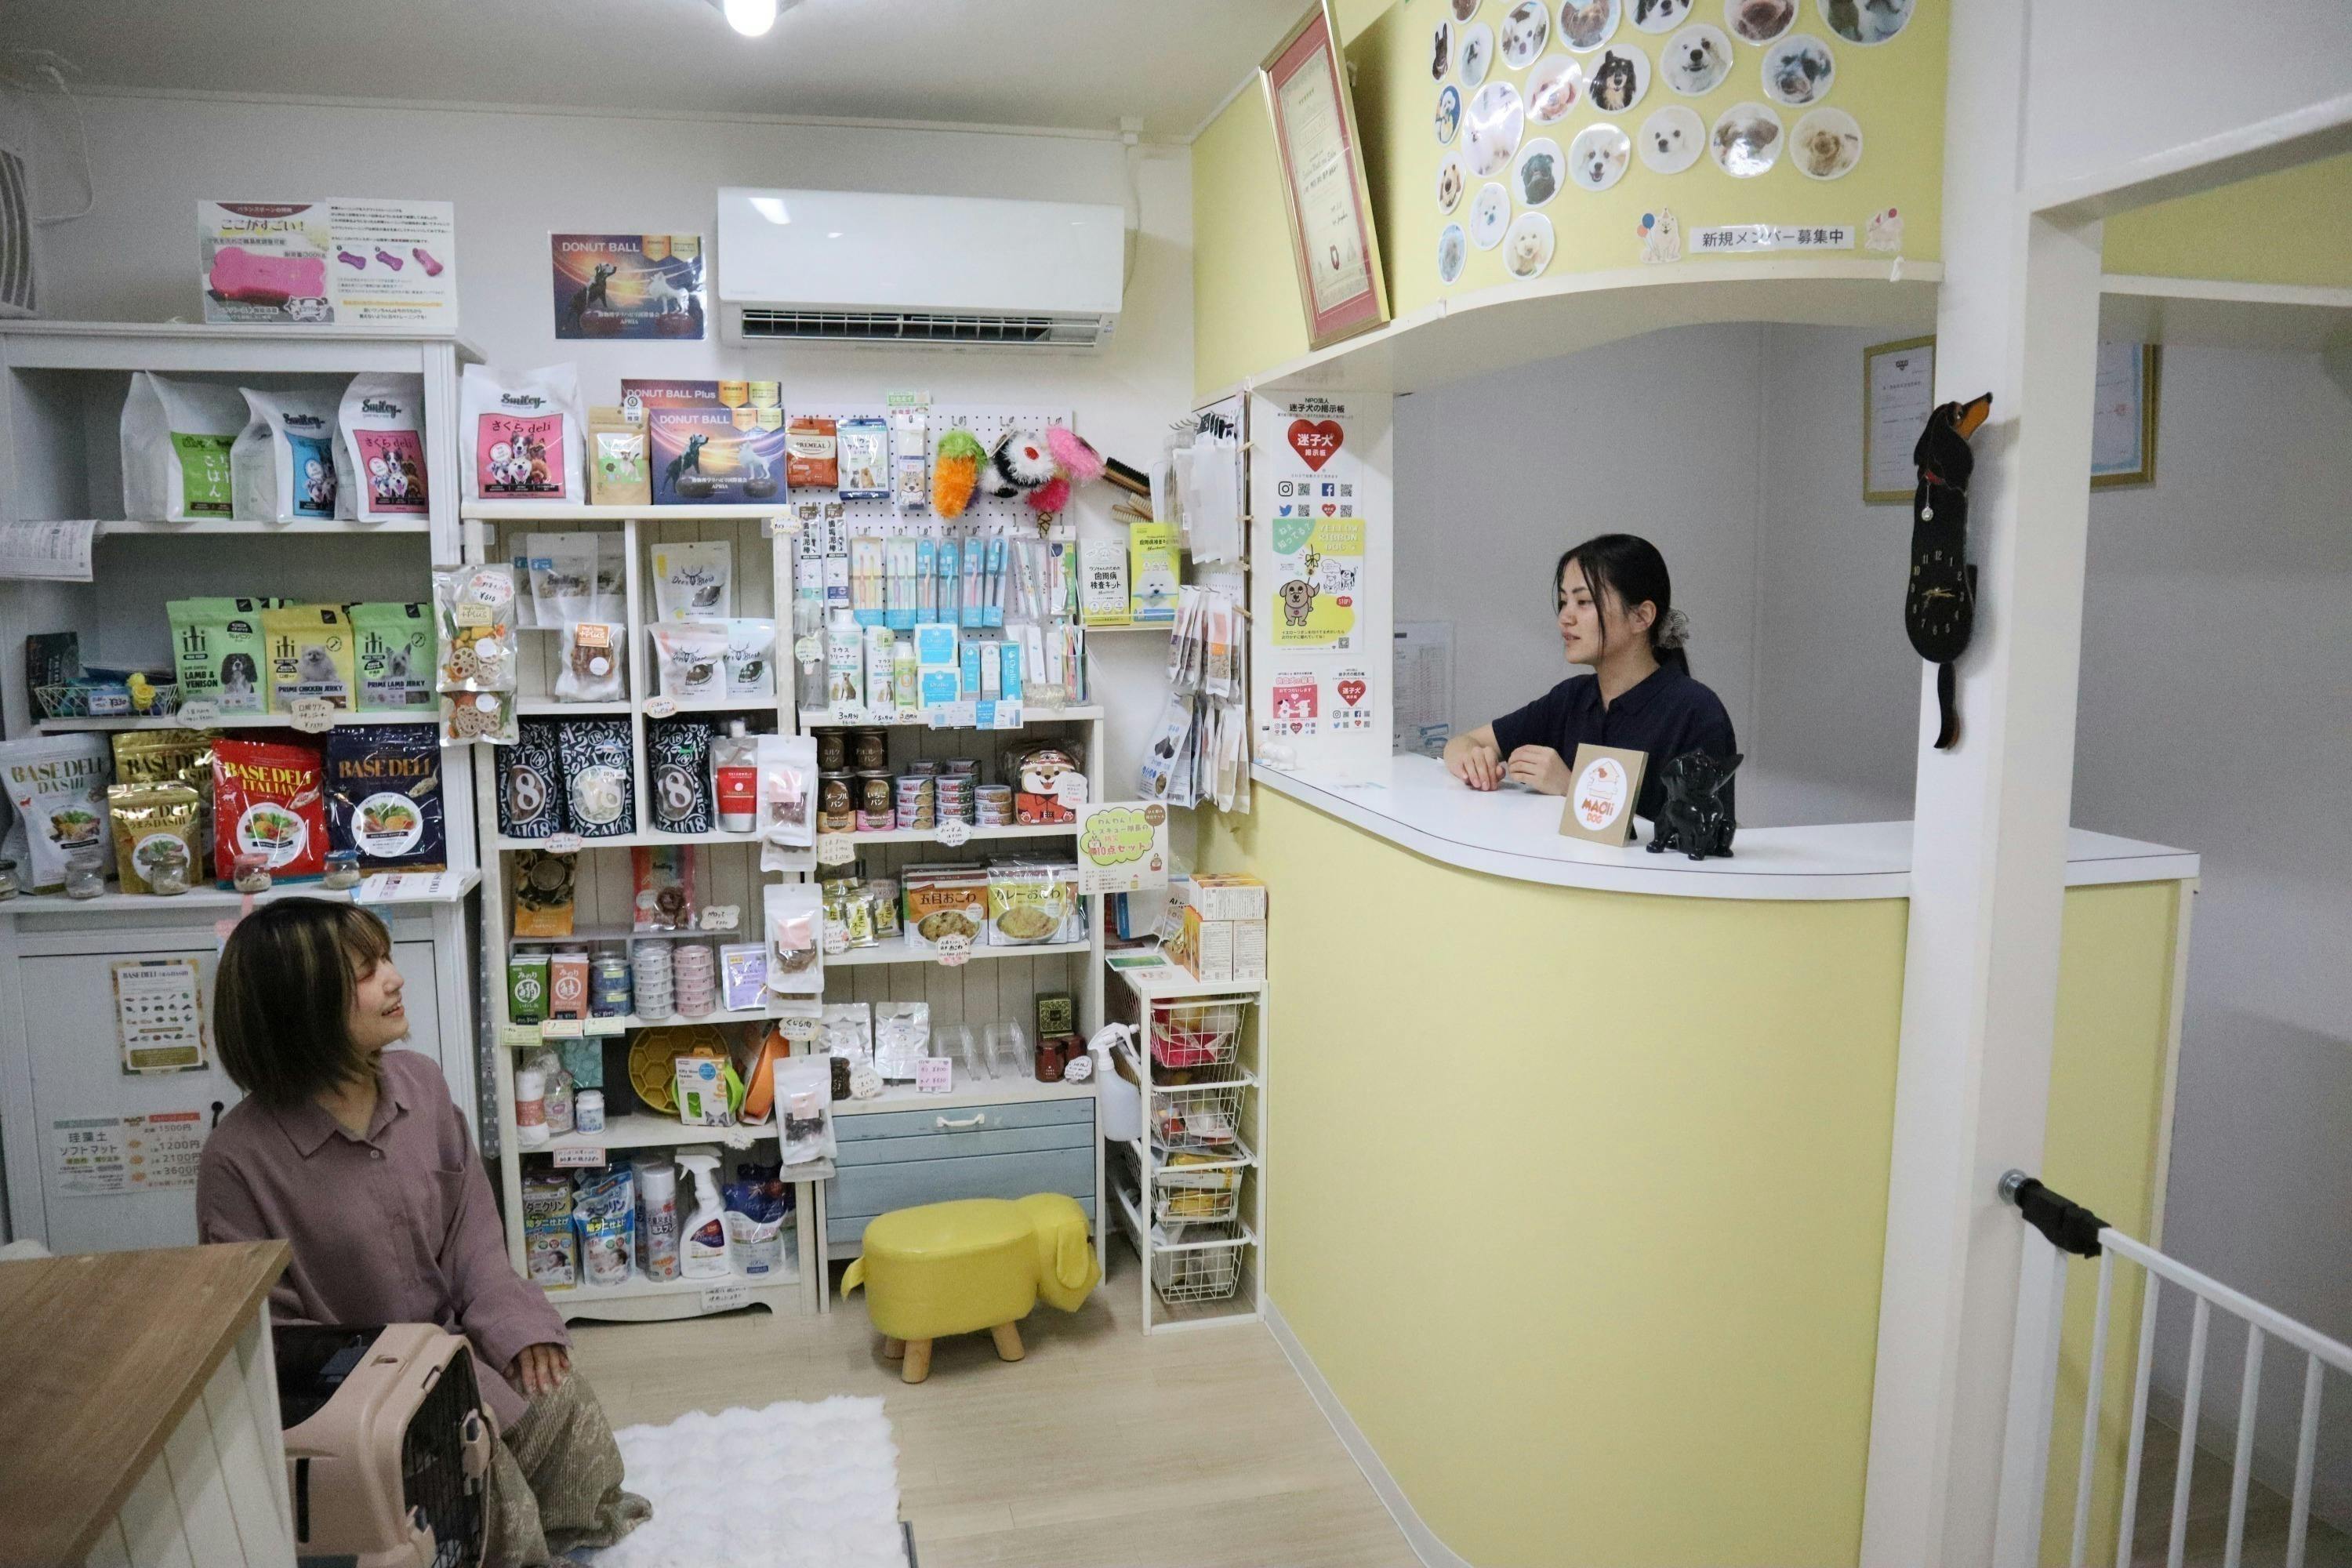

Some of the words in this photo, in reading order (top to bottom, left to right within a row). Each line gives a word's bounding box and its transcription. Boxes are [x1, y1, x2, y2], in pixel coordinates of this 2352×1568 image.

[1702, 228, 1844, 247] 新規メンバー募集中
[561, 242, 605, 252] DONUT
[608, 242, 640, 252] BALL
[626, 389, 664, 398] DONUT
[666, 389, 692, 398] BALL
[500, 393, 546, 408] Smiley
[362, 399, 401, 419] Smiley
[1289, 404, 1345, 413] 迷子犬の掲示板
[659, 415, 699, 424] DONUT
[702, 416, 730, 424] BALL
[492, 420, 524, 433] さくら
[528, 423, 551, 433] deli
[365, 437, 391, 448] さくら
[394, 437, 413, 448] deli
[1298, 434, 1333, 446] 迷子犬
[1922, 554, 1929, 564] 11
[1935, 550, 1942, 561] 12
[1914, 565, 1920, 575] 10
[1957, 571, 1962, 580] 2
[1911, 583, 1915, 593] 9
[1960, 591, 1964, 602] 3
[1933, 625, 1937, 635] 6
[1945, 623, 1950, 633] 5
[184, 671, 207, 680] LAMB
[186, 680, 218, 688] VENISON
[11, 761, 61, 782] BASE
[63, 757, 103, 776] DELI
[126, 753, 172, 775] BASE
[339, 760, 387, 779] BASE
[389, 758, 430, 777] DELI
[225, 761, 270, 782] BASE
[271, 768, 311, 786] DELI
[38, 777, 83, 794] DASHI
[242, 780, 296, 797] ITALIAN
[1587, 813, 1602, 824] DOG
[920, 891, 977, 905] 五目おこわ
[994, 889, 1061, 901] カレーおこわ
[159, 1140, 201, 1149] 1200円
[60, 1145, 118, 1156] ソフトマット
[162, 1152, 201, 1163] 2100円
[526, 1202, 566, 1213] ダニクリン
[587, 1200, 626, 1215] ダニクリン
